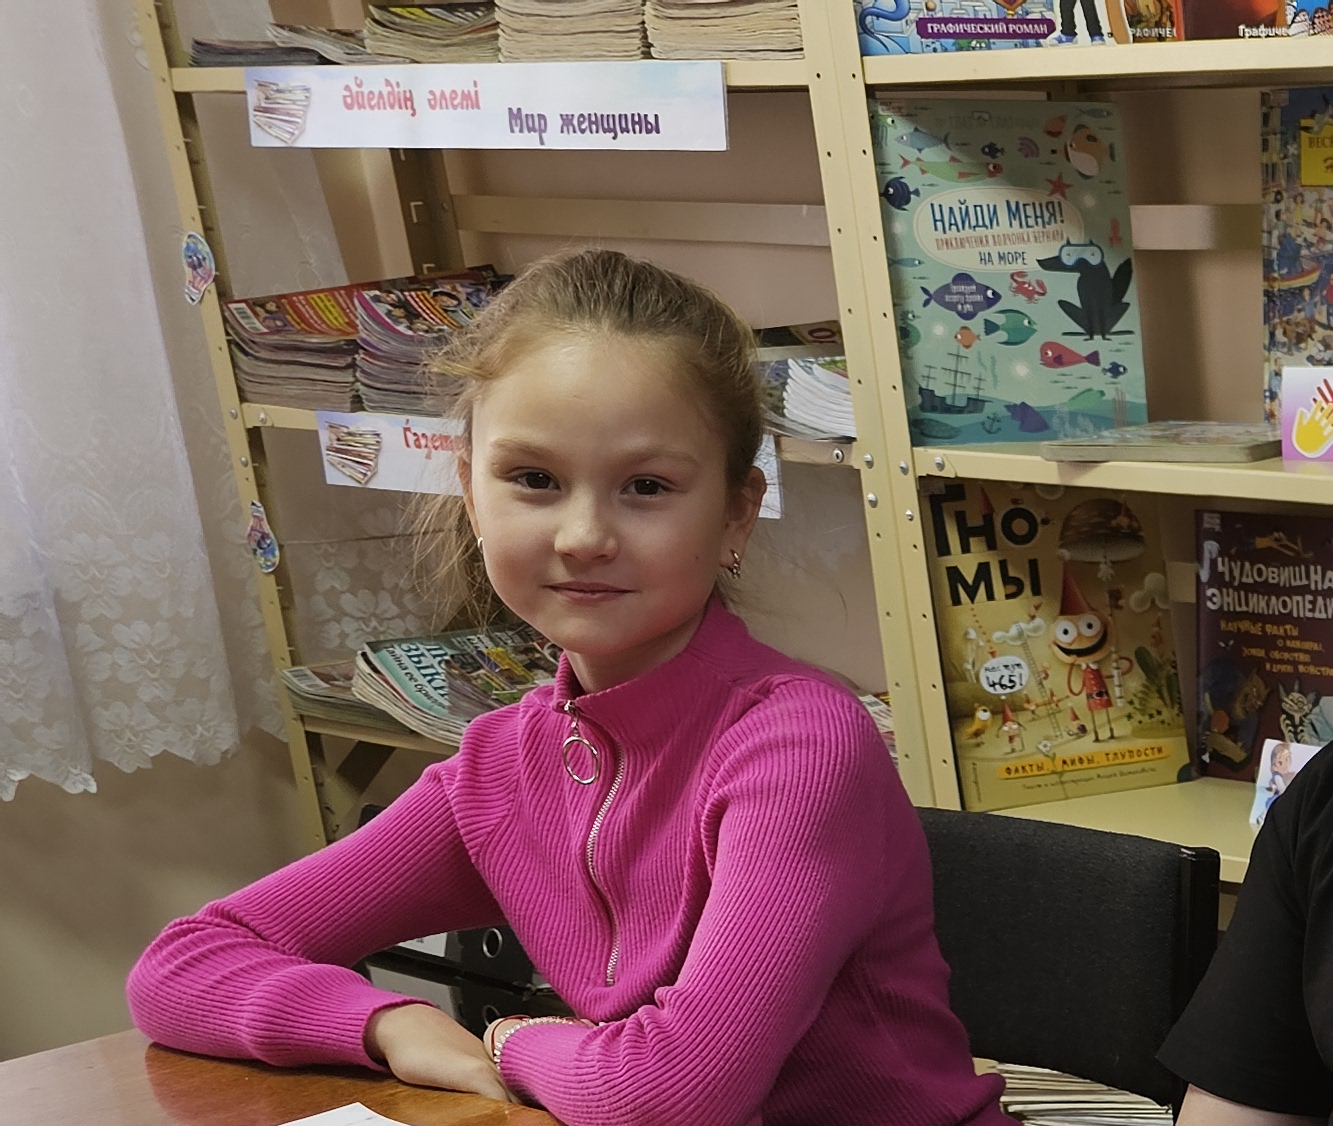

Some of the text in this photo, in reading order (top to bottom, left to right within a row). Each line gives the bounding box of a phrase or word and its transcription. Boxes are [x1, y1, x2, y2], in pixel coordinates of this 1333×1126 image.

[927, 21, 1049, 35] ГРАФИЧЕСКИЙ РОМАН
[342, 76, 481, 117] Әйелдің әлемі
[508, 107, 661, 145] Мир женщины
[930, 199, 1066, 234] НАЙДИ МЕНЯ!
[979, 251, 1028, 266] НА МОРЕ
[1220, 619, 1299, 637] НАУЧНЫЕ ФАКТЫ
[986, 672, 1024, 690] 465!
